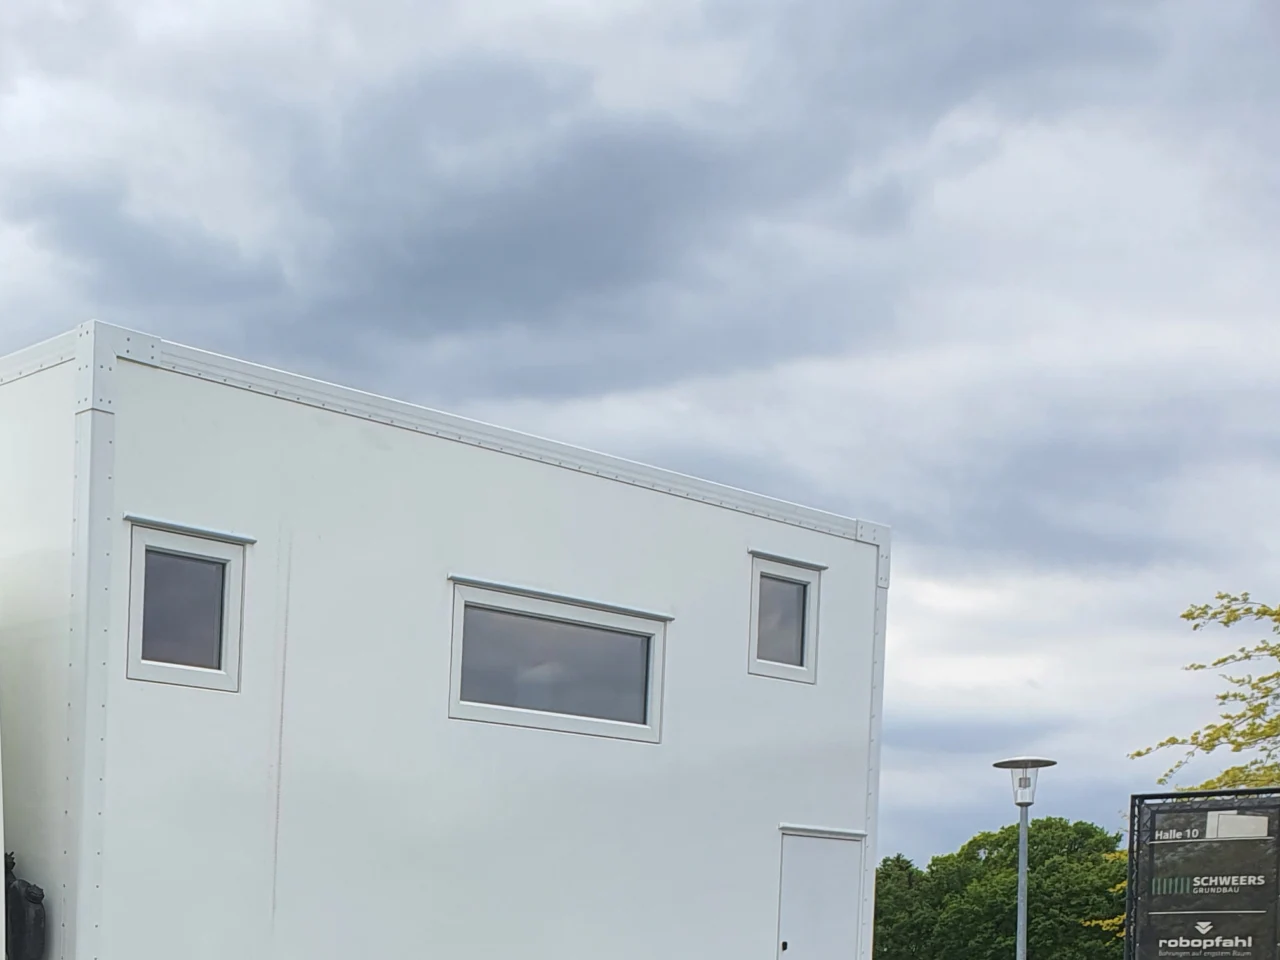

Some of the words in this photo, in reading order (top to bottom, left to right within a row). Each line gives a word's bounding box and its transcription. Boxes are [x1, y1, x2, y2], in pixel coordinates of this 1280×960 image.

[1155, 829, 1182, 840] Halle
[1185, 829, 1199, 839] 10
[1193, 875, 1265, 886] SCHWEERS
[1158, 936, 1252, 950] robopfahl
